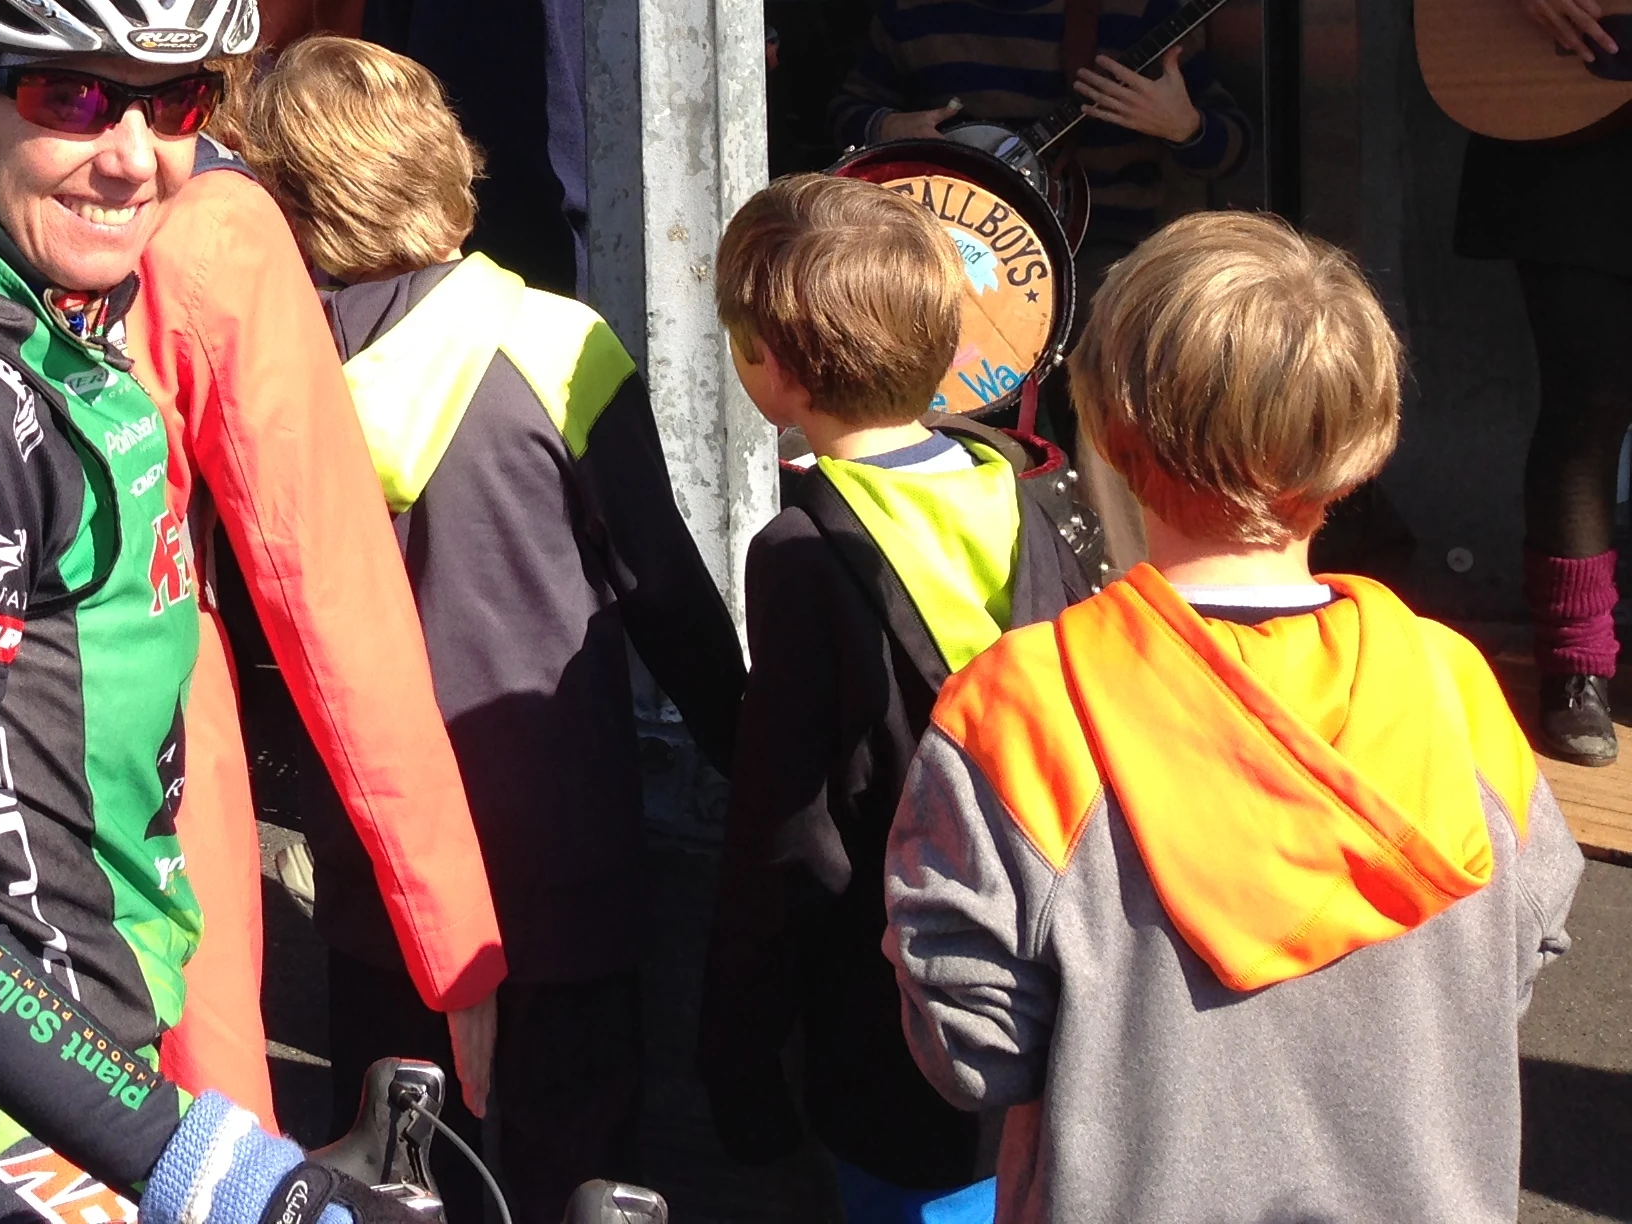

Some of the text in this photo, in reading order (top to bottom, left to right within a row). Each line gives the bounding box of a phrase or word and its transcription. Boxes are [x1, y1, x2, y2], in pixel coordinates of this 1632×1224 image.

[135, 32, 202, 44] RUDY
[11, 968, 73, 1022] PLANT
[60, 1030, 151, 1112] Plant
[83, 1026, 158, 1088] INDOOR
